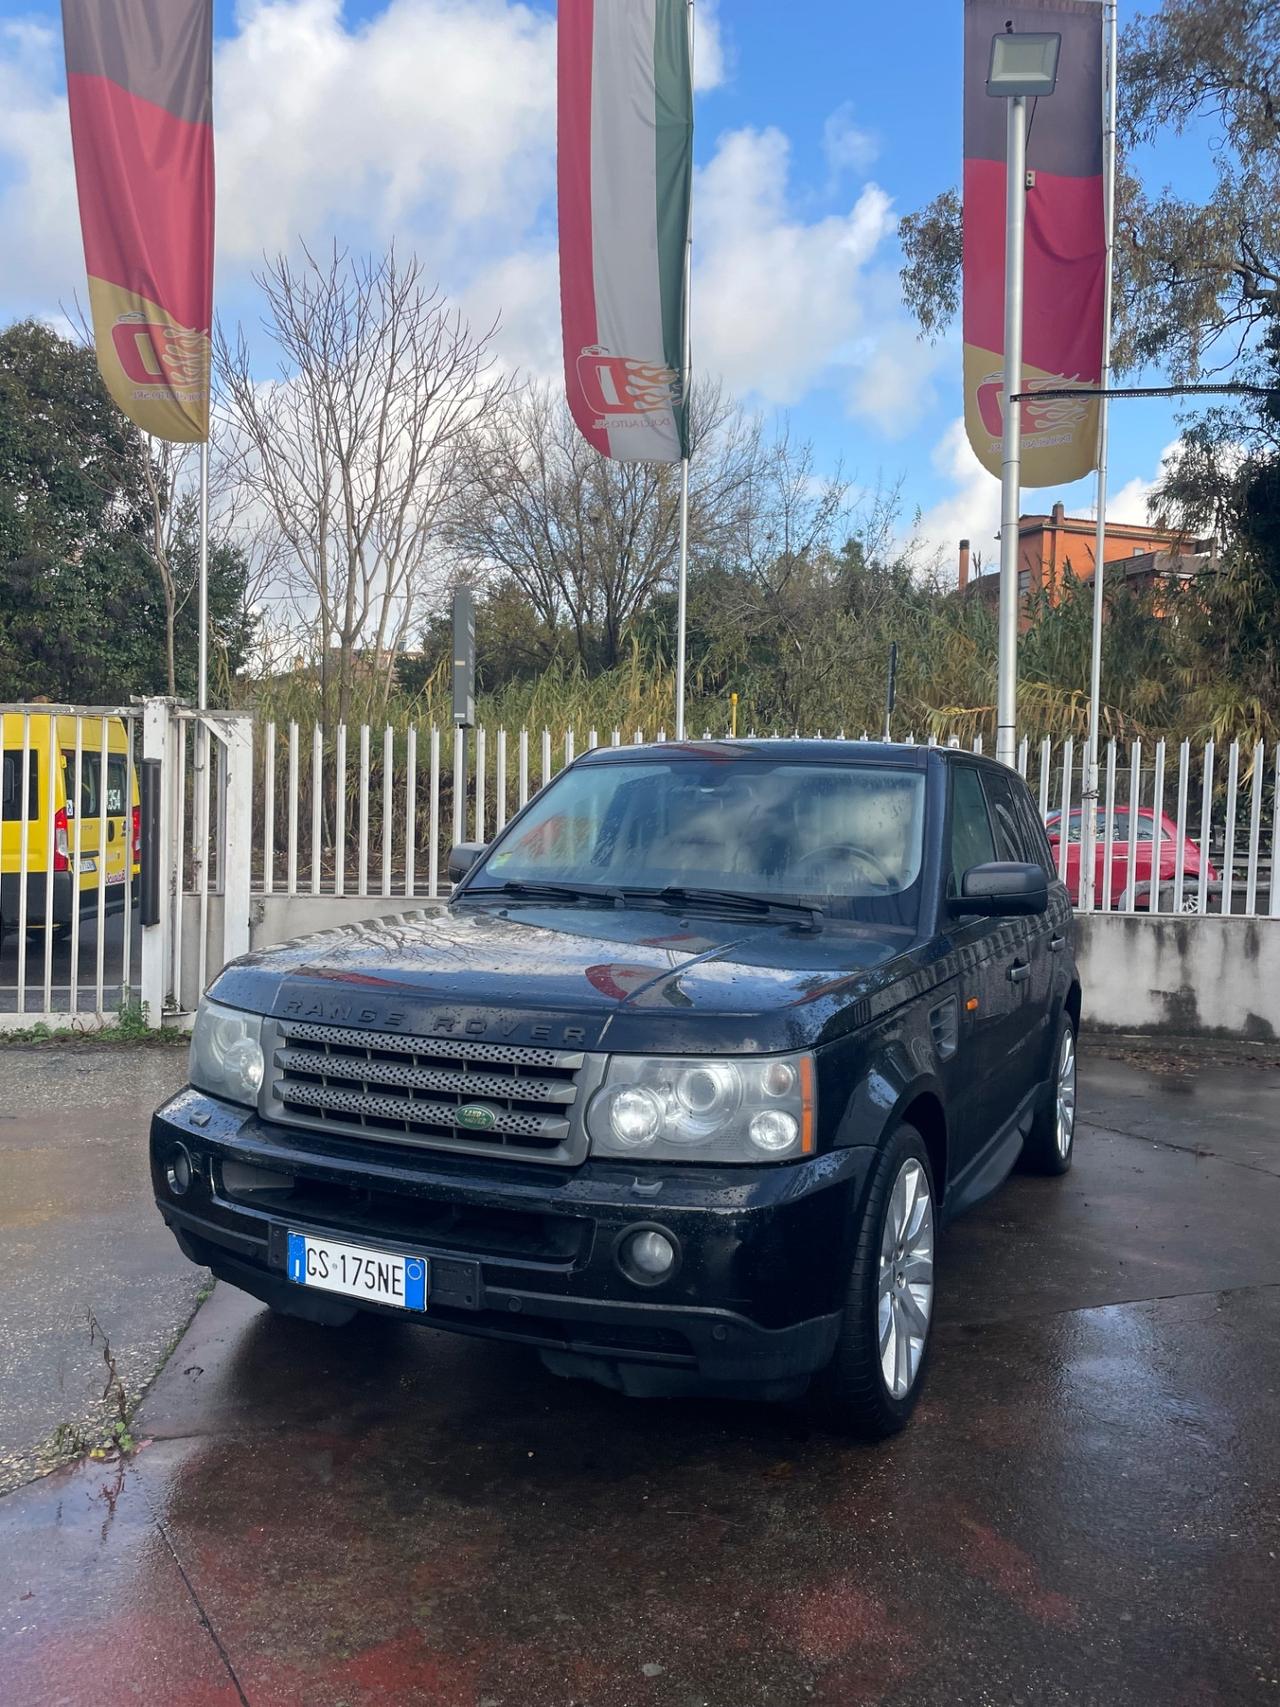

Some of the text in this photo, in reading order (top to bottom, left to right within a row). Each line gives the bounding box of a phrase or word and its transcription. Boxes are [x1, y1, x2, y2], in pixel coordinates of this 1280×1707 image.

[283, 1001, 586, 1045] RANGE ROVER
[306, 1247, 403, 1296] GS 175NE
